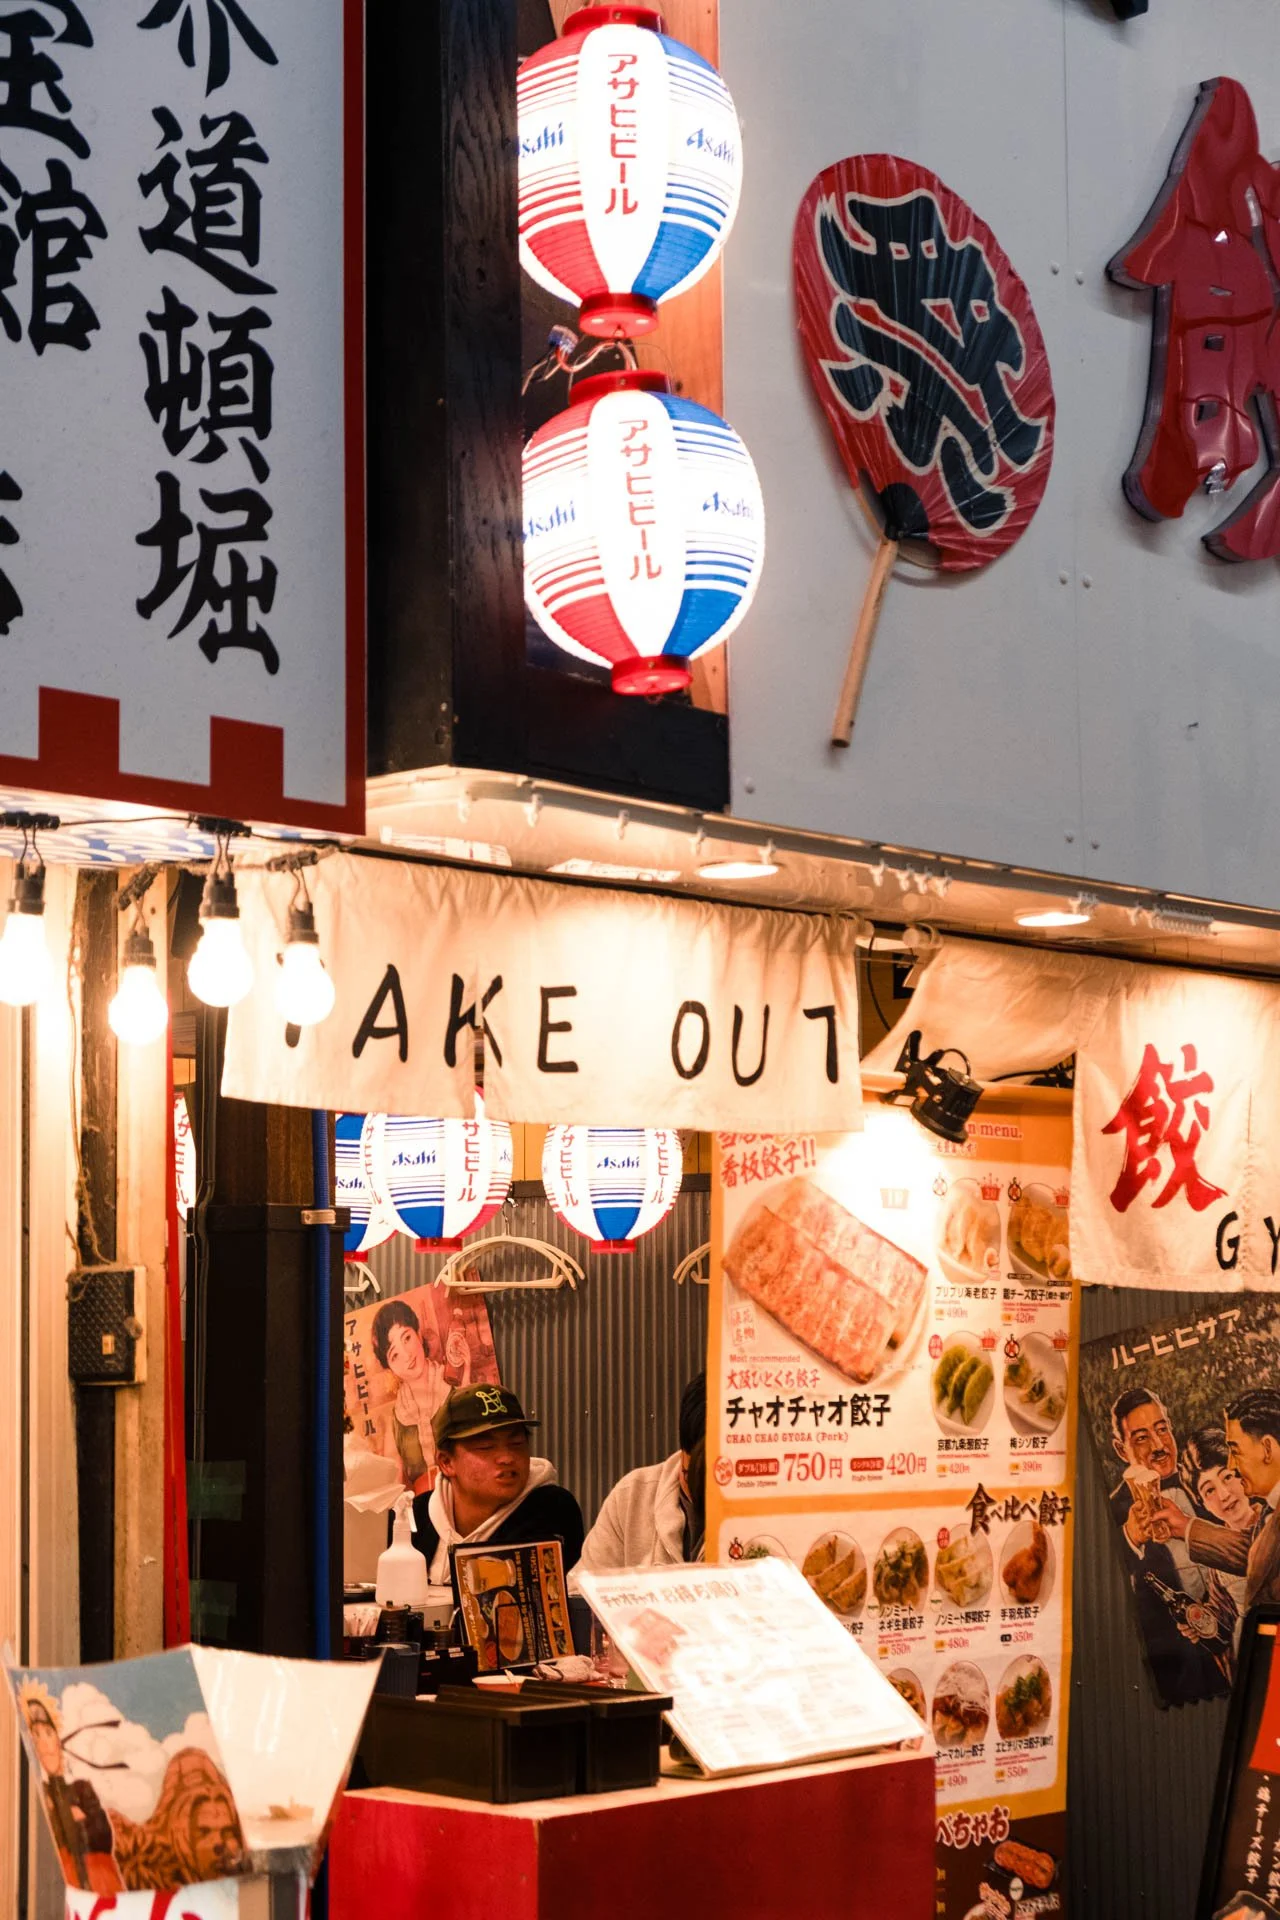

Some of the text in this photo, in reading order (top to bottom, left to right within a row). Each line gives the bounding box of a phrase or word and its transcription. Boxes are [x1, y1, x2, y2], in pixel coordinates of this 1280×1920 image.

[605, 54, 640, 216] アサヒビール
[618, 419, 663, 581] アサヒビール
[276, 951, 580, 1074] AKE
[1101, 1043, 1230, 1214] 餃
[391, 1150, 437, 1167] Asahi
[596, 1156, 641, 1170] Asahi
[346, 1319, 377, 1437] アサヒビール
[725, 1393, 892, 1428] チャオチャオ餃子
[726, 1434, 752, 1444] CHAO
[755, 1433, 779, 1443] CHAO
[783, 1452, 843, 1482] 750円
[886, 1452, 928, 1476] 420円
[965, 1484, 1072, 1535] 食べ比べ餃子
